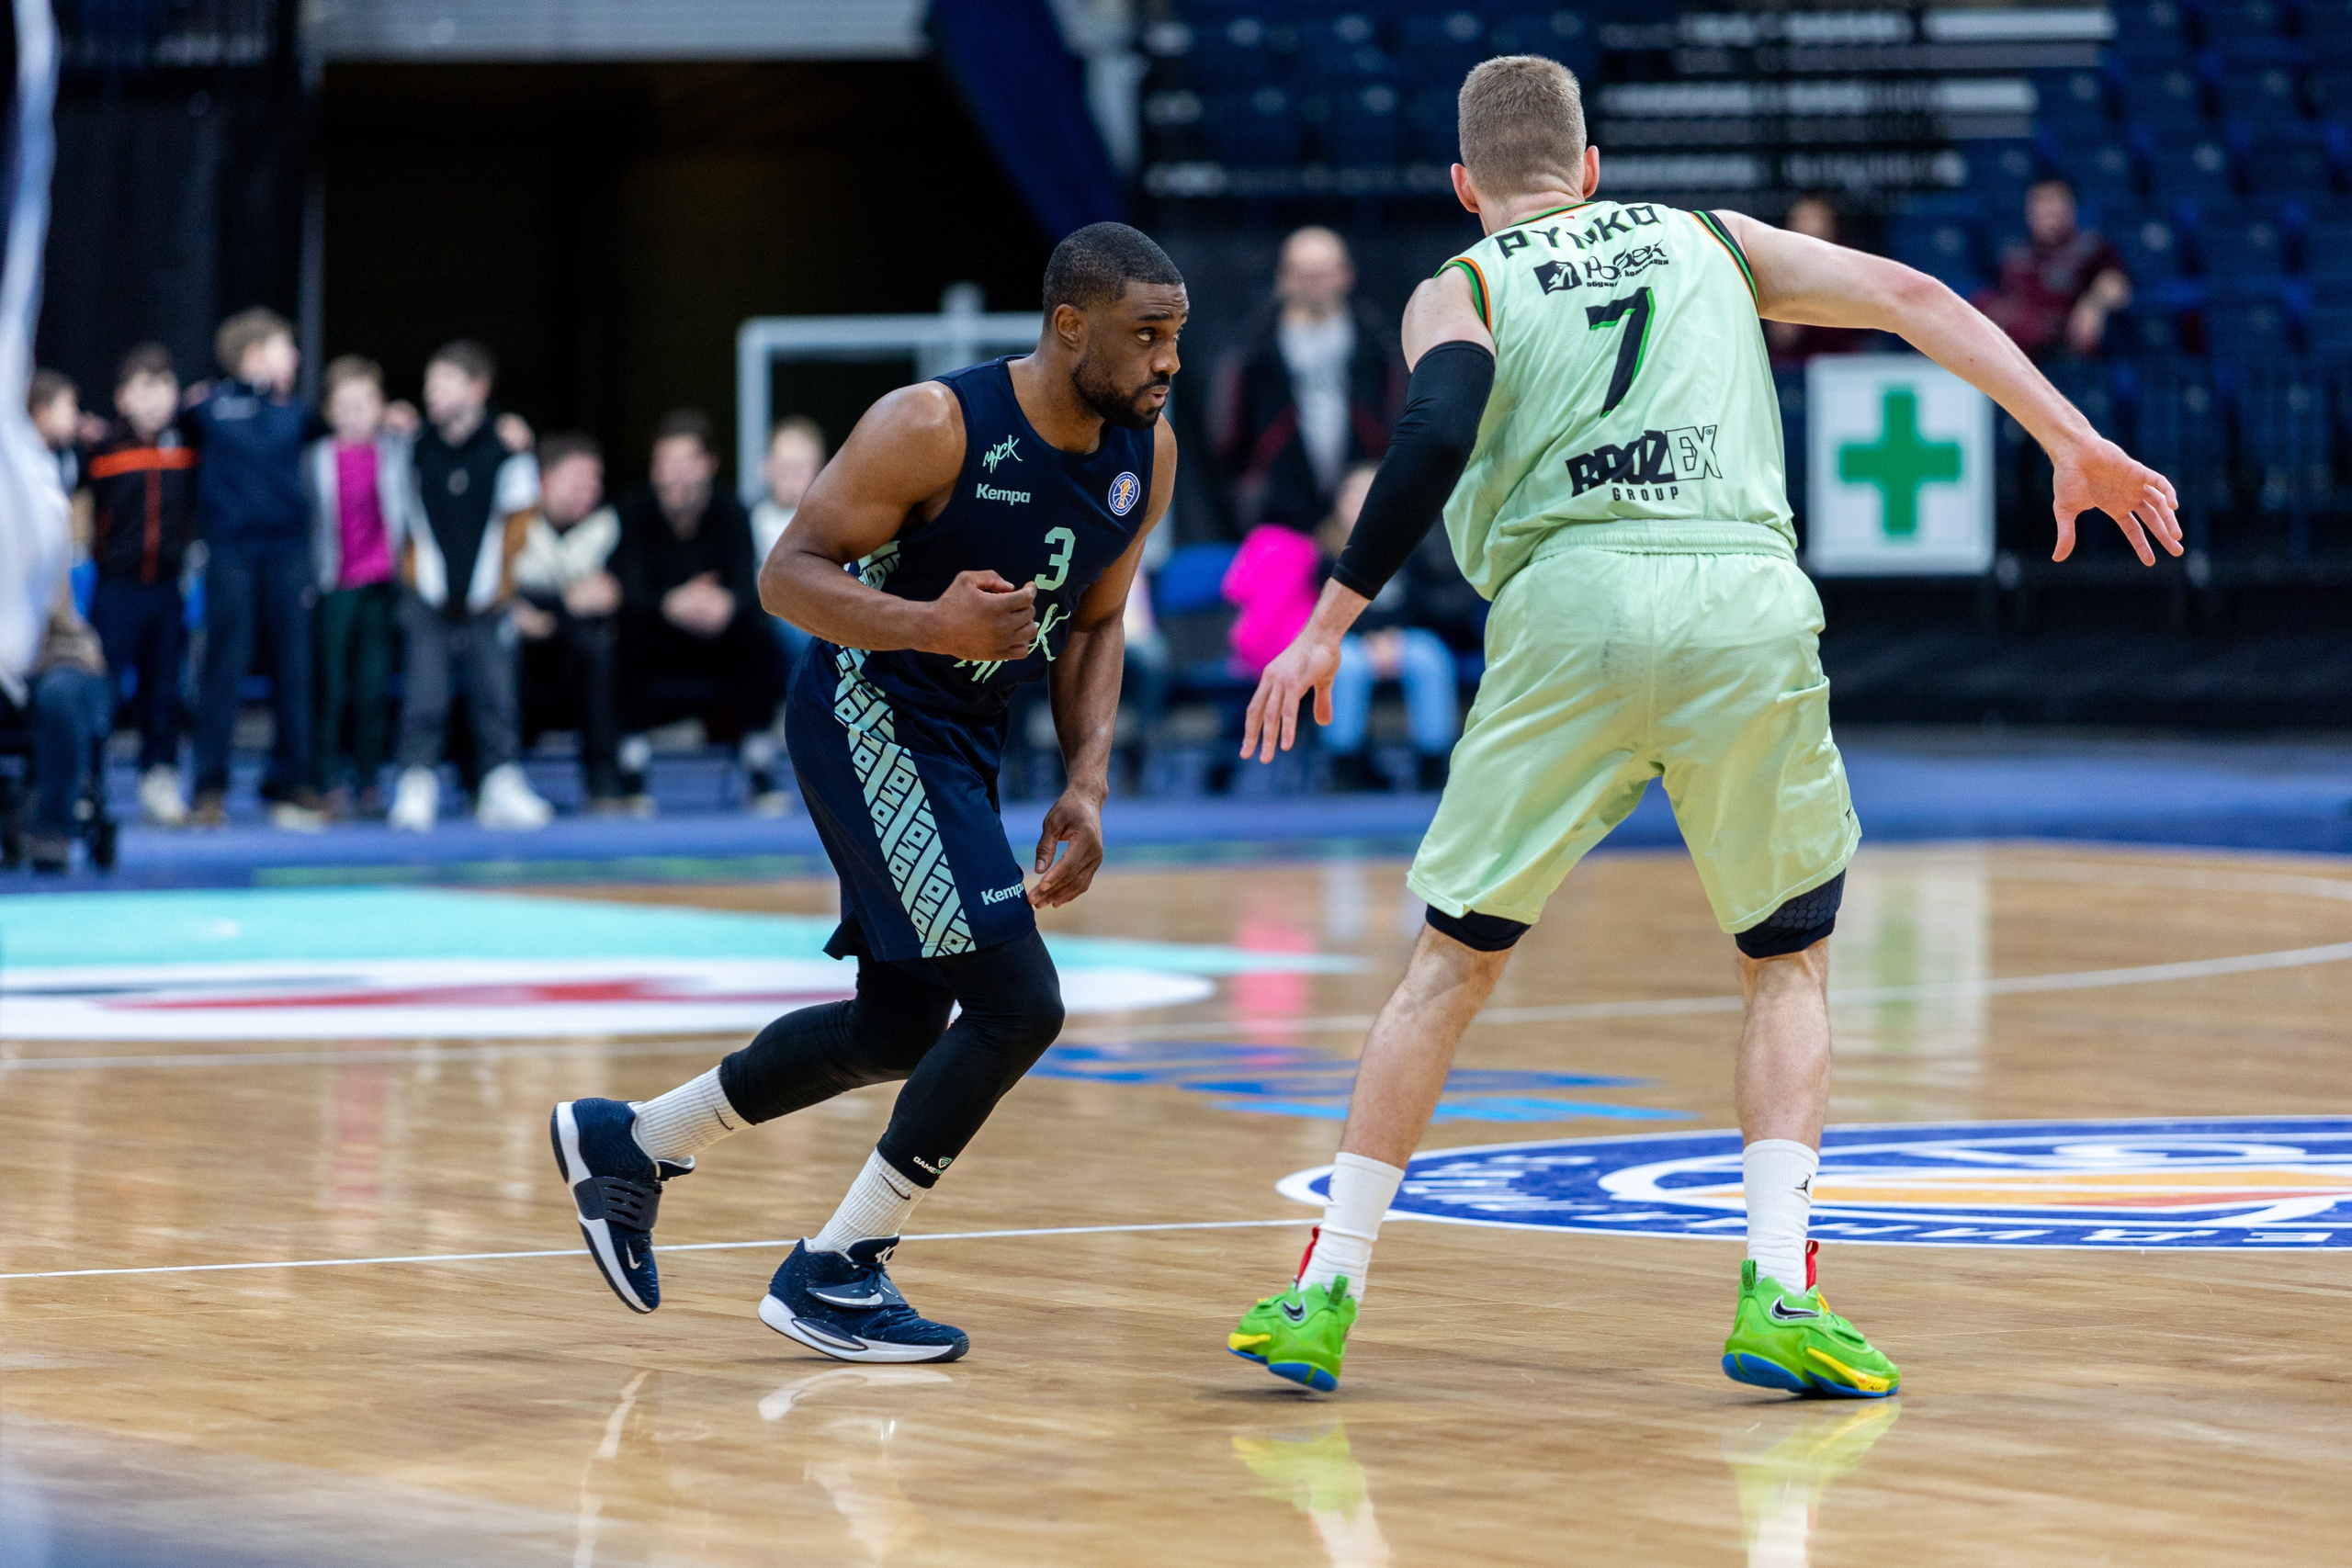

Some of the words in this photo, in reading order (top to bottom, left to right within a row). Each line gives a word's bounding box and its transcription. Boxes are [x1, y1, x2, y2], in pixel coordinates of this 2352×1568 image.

[1585, 287, 1656, 419] 7
[976, 482, 1031, 506] Kempa
[1612, 486, 1679, 502] GROUP
[1035, 526, 1076, 591] 3
